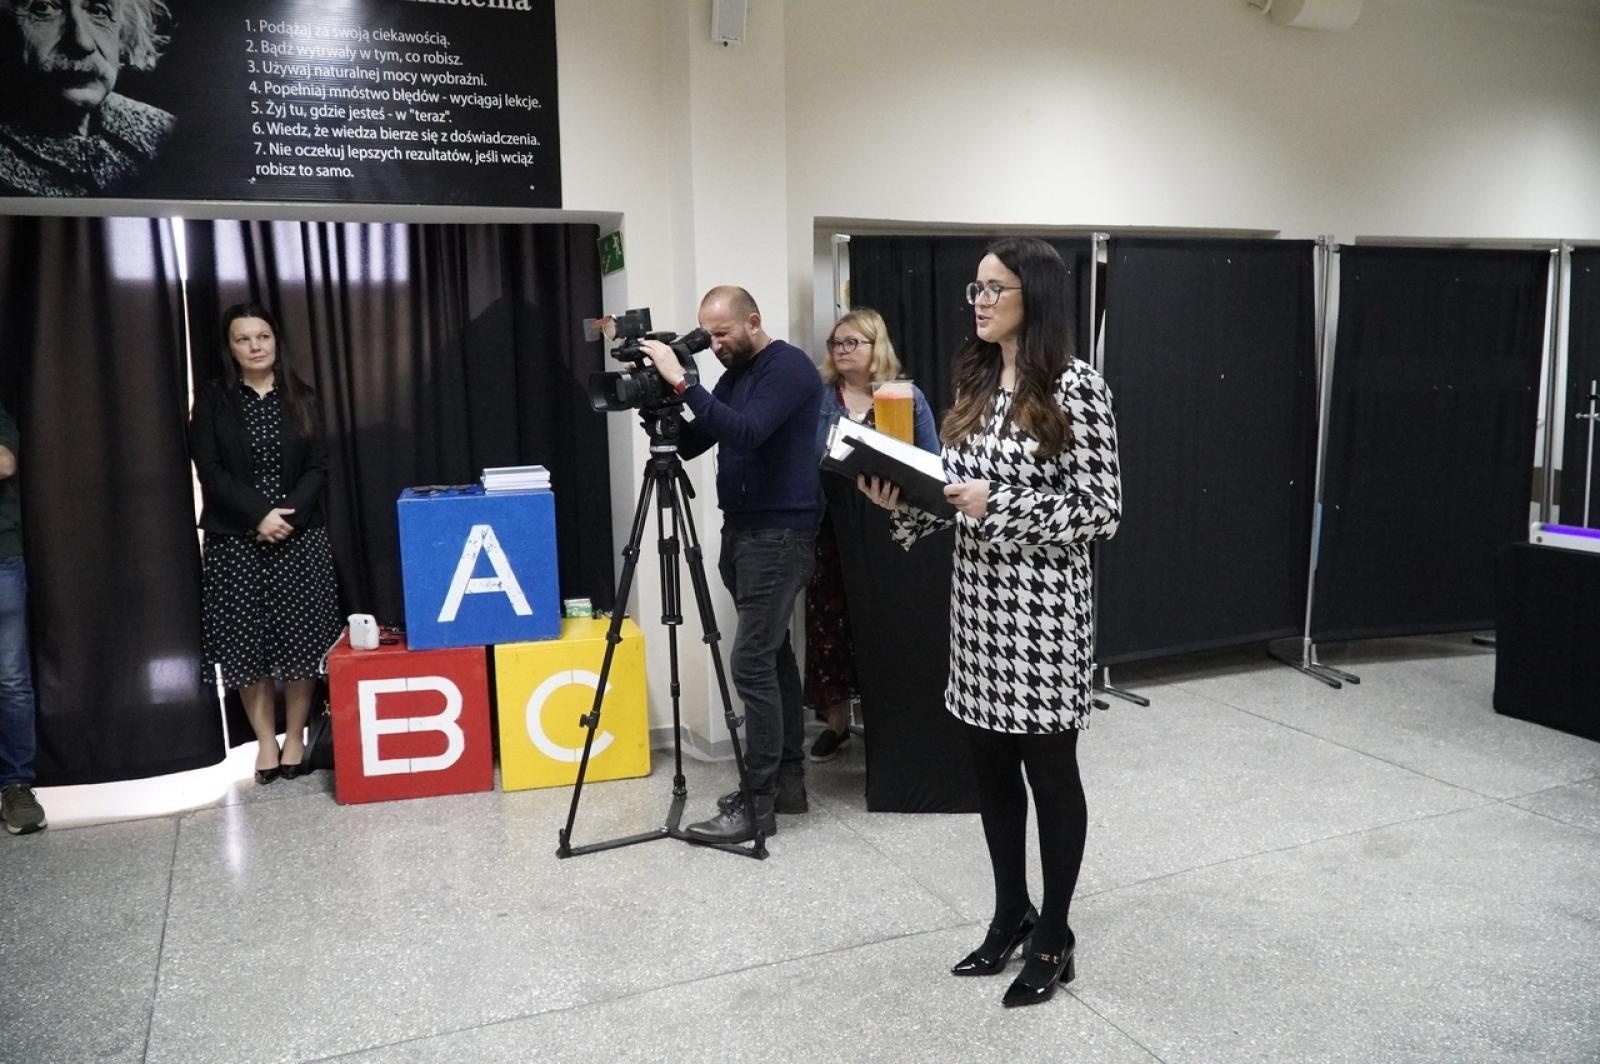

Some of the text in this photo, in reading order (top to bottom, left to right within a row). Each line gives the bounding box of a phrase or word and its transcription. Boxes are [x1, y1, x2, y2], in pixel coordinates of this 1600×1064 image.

[245, 20, 451, 48] 1. Podążaj za swoją ciekawością.
[246, 40, 258, 53] 2.
[261, 40, 295, 57] Bądź
[360, 49, 371, 60] w
[374, 48, 402, 64] tym,
[405, 52, 421, 63] co
[423, 50, 464, 66] robisz.
[247, 60, 488, 87] 3. Używaj naturalnej mocy wyobraźni.
[249, 80, 261, 94] 4.
[264, 80, 327, 100] Popełniaj
[329, 85, 390, 101] mnóstwo
[392, 87, 440, 105] błędów
[449, 92, 502, 110] wyciągaj
[504, 93, 542, 111] lekcje.
[250, 101, 263, 115] 5.
[265, 99, 287, 119] Żyj
[289, 103, 307, 118] tu,
[309, 104, 346, 120] gdzie
[348, 105, 386, 122] jesteś
[395, 110, 407, 121] w
[409, 108, 452, 123] "teraz".
[252, 121, 541, 146] 6. Wiedz, że wiedza bierze się z doświadczenia.
[253, 141, 534, 167] 7. Nie oczekuj lepszych rezultatów, jeśli wciąż
[255, 162, 355, 178] robisz to samo.
[437, 523, 533, 623] A
[357, 675, 465, 777] B
[526, 668, 615, 764] C
